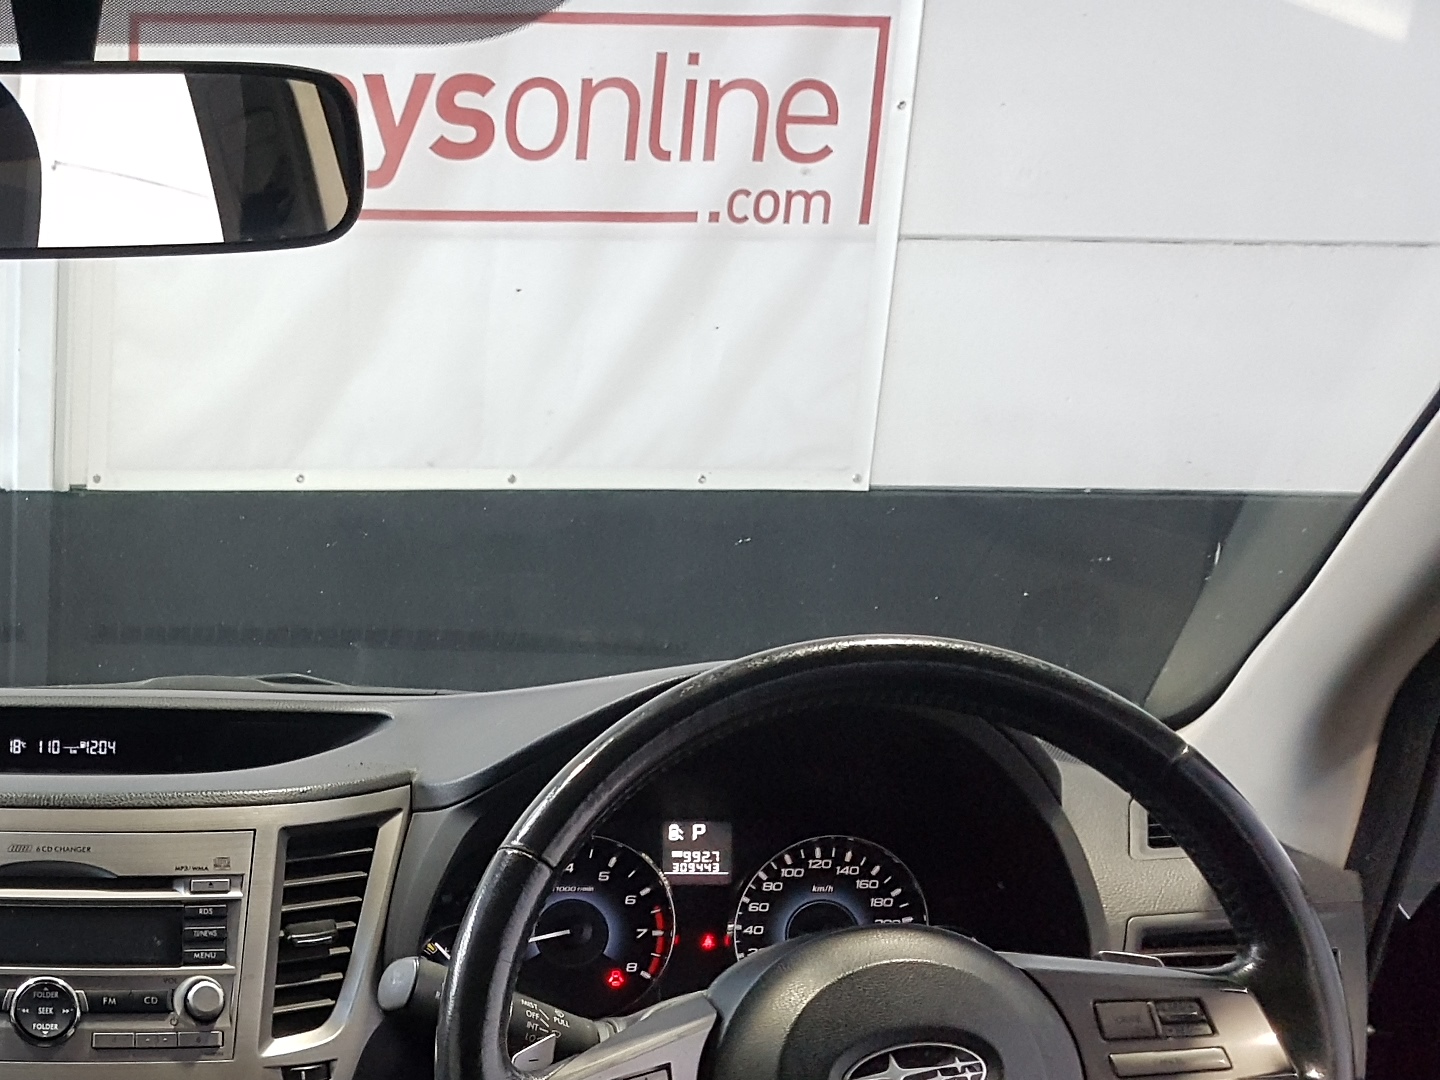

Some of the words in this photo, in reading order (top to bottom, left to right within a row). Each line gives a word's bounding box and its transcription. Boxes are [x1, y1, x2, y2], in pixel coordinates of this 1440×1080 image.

[342, 51, 838, 188] ysonline
[707, 188, 831, 224] .com
[692, 823, 707, 841] P
[41, 845, 53, 853] CD
[54, 845, 92, 853] CHANGER
[564, 862, 575, 873] 4
[808, 859, 832, 870] 120
[780, 868, 804, 878] 100
[836, 865, 860, 876] 140
[598, 871, 611, 882] 5
[762, 881, 783, 892] 80
[812, 884, 834, 893] km/h
[856, 879, 879, 890] 160
[625, 895, 637, 905] 6
[870, 897, 894, 908] 180
[748, 902, 770, 913] 60
[636, 928, 648, 939] 7
[743, 925, 765, 935] 40
[193, 951, 217, 959] MENU
[626, 962, 638, 972] 8
[102, 997, 117, 1005] FM
[143, 996, 159, 1005] CD
[38, 1006, 54, 1015] SEEK
[525, 1009, 540, 1020] OFF
[32, 1023, 59, 1031] FOLDER
[526, 1021, 540, 1031] INT
[553, 1016, 570, 1028] PULL
[525, 1033, 536, 1042] LO
